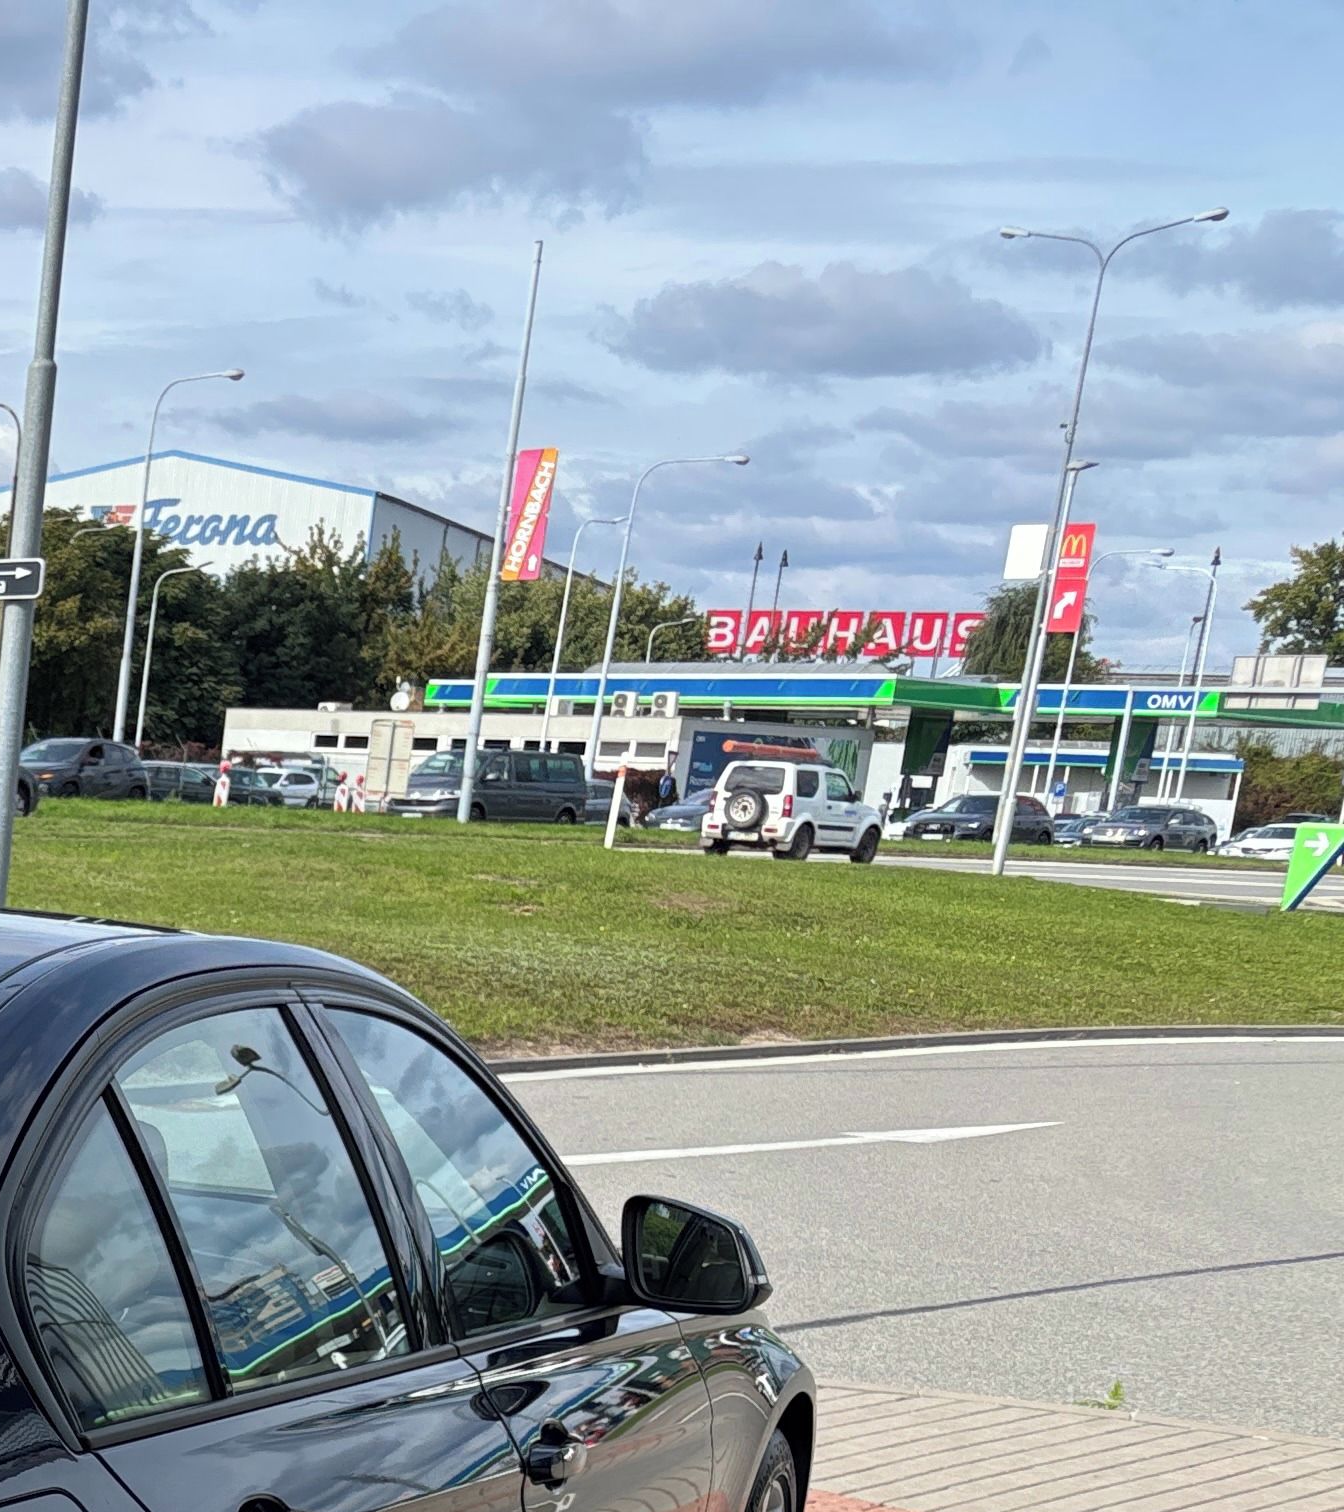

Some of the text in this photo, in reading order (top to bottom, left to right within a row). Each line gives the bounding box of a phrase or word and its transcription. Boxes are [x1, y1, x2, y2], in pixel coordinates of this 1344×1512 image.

[144, 498, 278, 546] Ferona
[505, 461, 555, 572] HORNBACH
[1146, 694, 1193, 709] OMV
